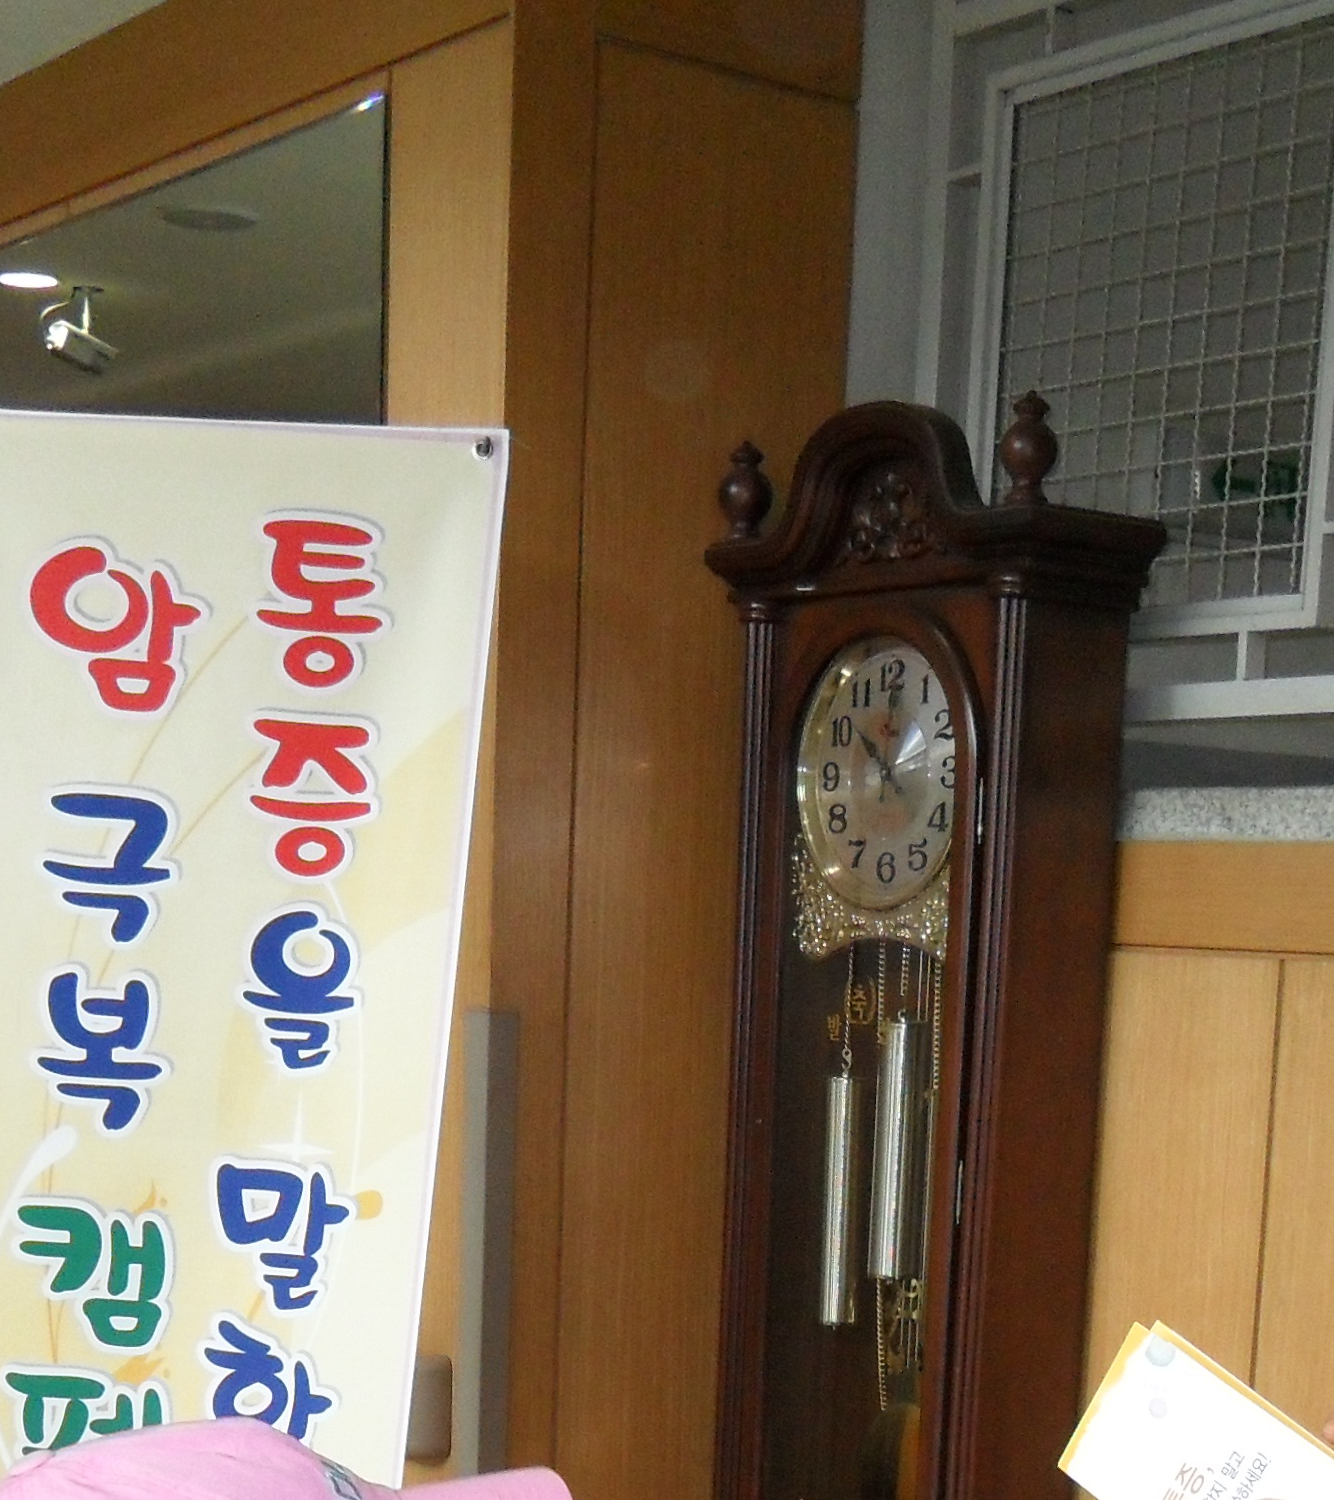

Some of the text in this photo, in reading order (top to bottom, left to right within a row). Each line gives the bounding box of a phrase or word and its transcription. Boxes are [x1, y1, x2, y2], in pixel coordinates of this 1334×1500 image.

[30, 545, 202, 712] 암
[851, 674, 872, 708] 11
[880, 657, 906, 693] 12
[920, 674, 930, 705] 1
[831, 715, 852, 747] 10
[934, 709, 955, 741] 2
[822, 762, 841, 792] 9
[241, 518, 383, 1069] 통증을
[828, 803, 848, 834] 8
[927, 801, 949, 833] 4
[849, 839, 867, 870] 7
[876, 852, 896, 884] 6
[907, 838, 928, 871] 5
[37, 792, 170, 1131] 극복
[1220, 1451, 1245, 1480] 말고
